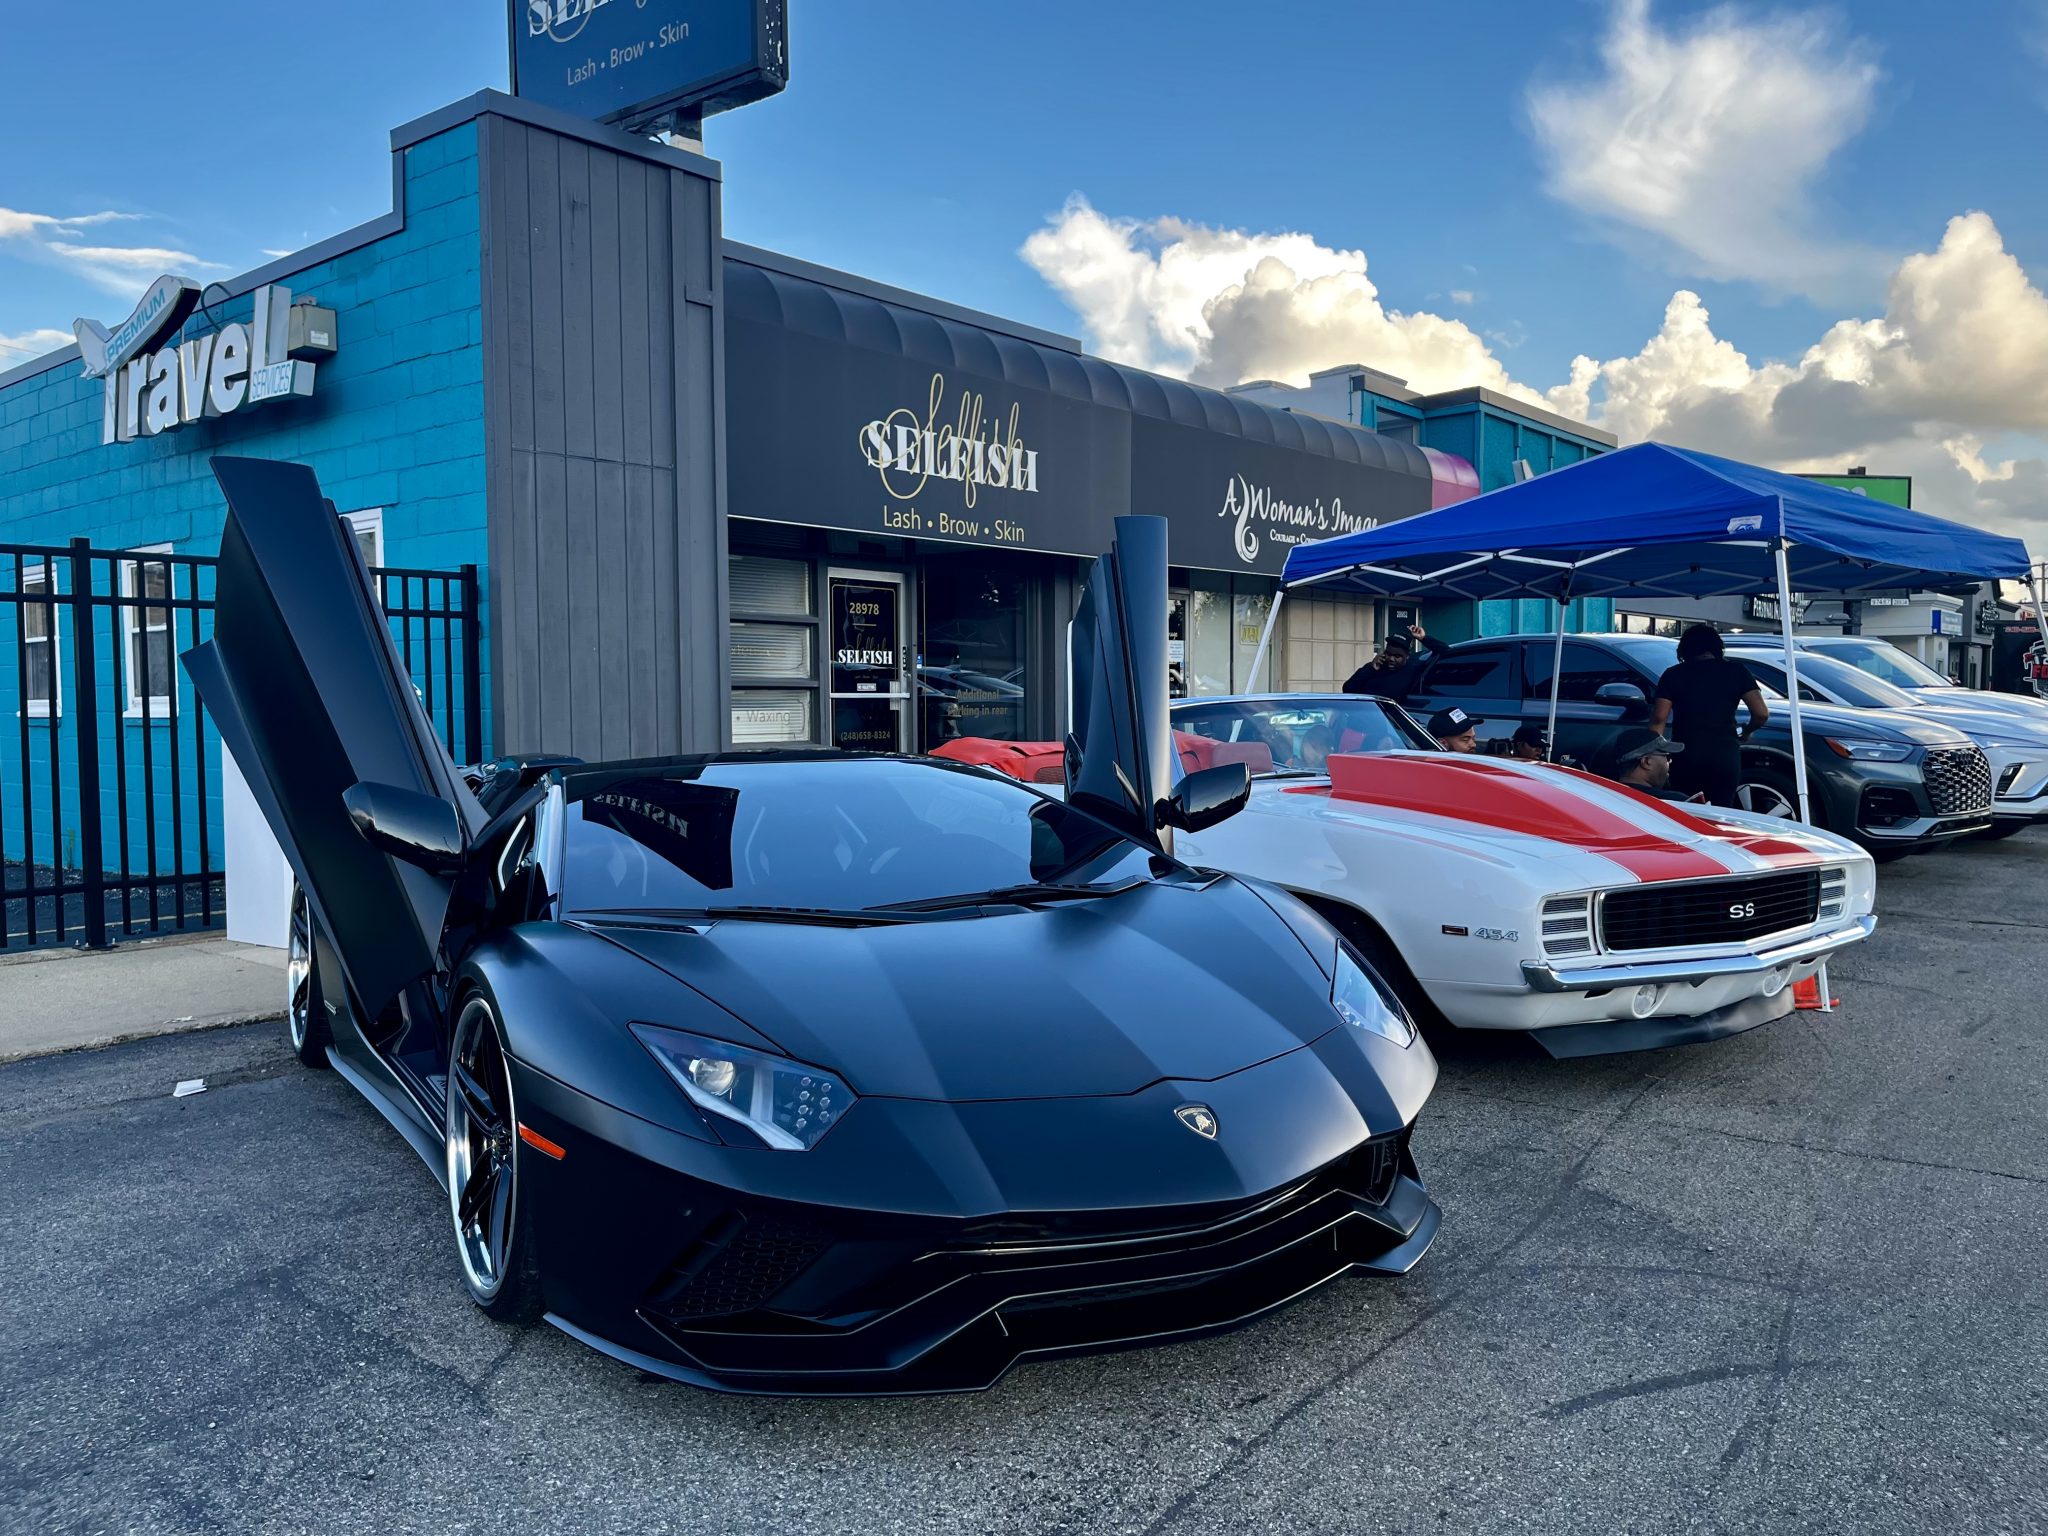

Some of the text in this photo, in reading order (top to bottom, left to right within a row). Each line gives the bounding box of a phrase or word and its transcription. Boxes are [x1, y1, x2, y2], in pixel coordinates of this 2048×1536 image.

[567, 20, 690, 86] Lash Brow Skin
[107, 287, 166, 364] PREMIUM
[251, 363, 291, 400] SERVICES
[867, 420, 1039, 493] SELFISH
[1218, 478, 1241, 517] A
[1250, 484, 1328, 530] Woman's
[883, 505, 1025, 542] Lash Brow Skin
[849, 602, 880, 615] 28978
[838, 649, 893, 665] SELFISH
[957, 688, 1000, 700] Additional
[747, 709, 791, 726] Waxing
[982, 704, 989, 716] in
[992, 707, 1009, 716] rear
[1729, 903, 1755, 919] SS
[1473, 926, 1519, 943] 454
